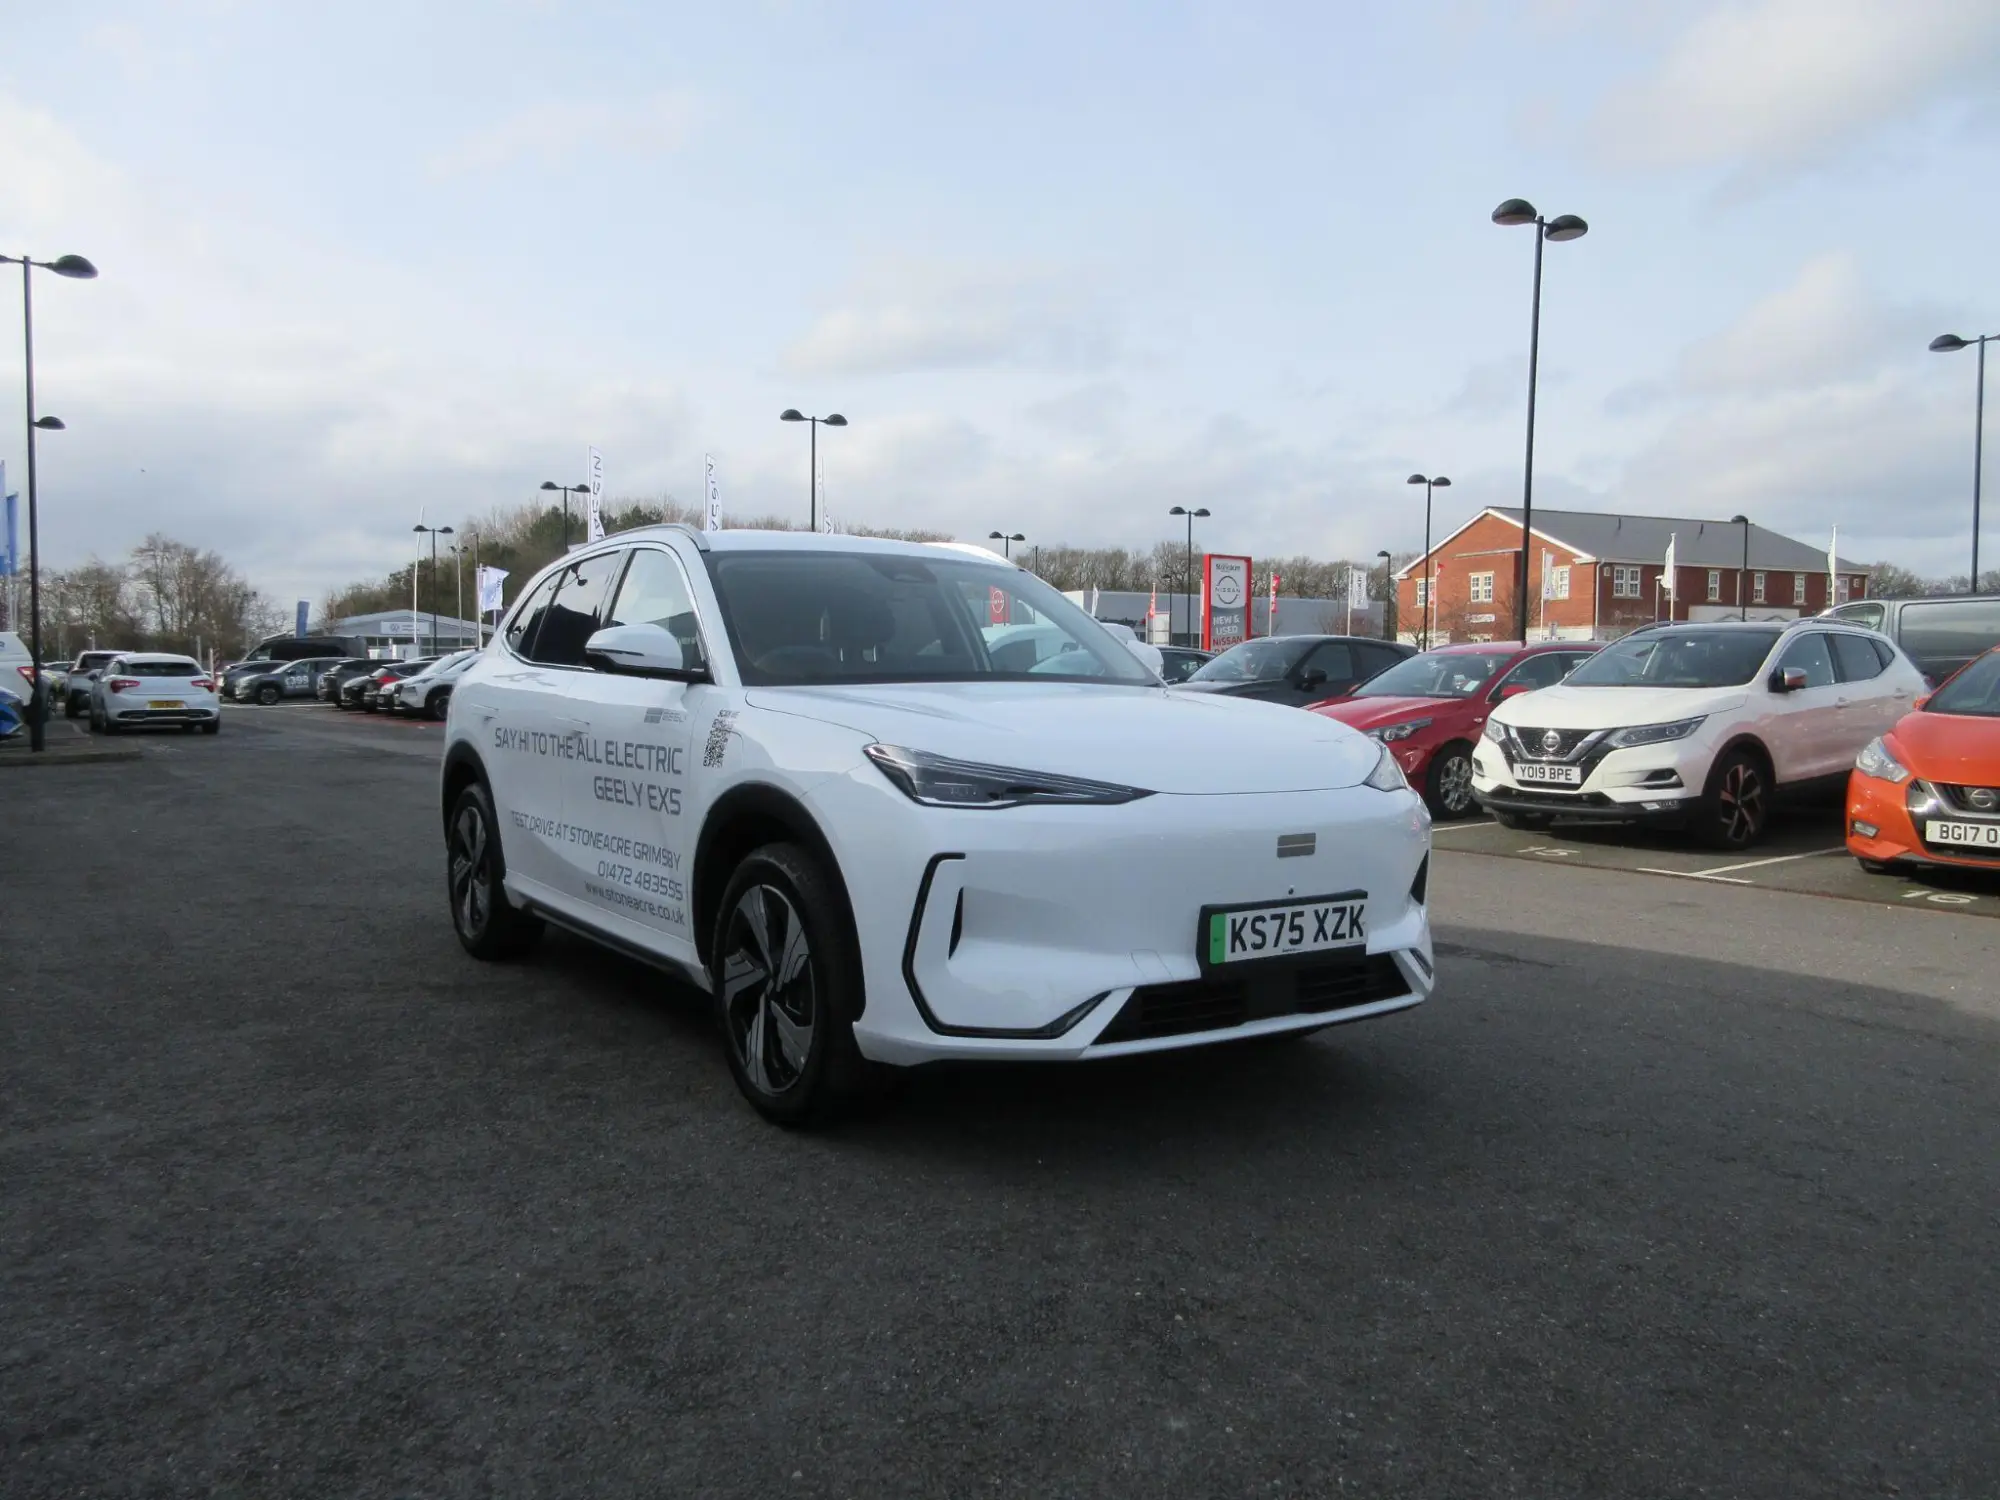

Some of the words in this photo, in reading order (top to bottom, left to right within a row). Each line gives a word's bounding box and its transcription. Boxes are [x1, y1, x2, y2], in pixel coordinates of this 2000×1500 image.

[708, 463, 719, 531] NISSA
[1213, 616, 1232, 626] NEW
[1216, 625, 1238, 635] USED
[1212, 636, 1243, 646] NISSAN
[495, 727, 517, 749] SAY
[519, 730, 529, 753] HI
[531, 731, 547, 756] TO
[549, 733, 574, 760] THE
[576, 735, 603, 764] ALL
[605, 740, 683, 775] ELECTRIC
[1520, 766, 1546, 779] YO19
[1549, 768, 1573, 781] BPE
[594, 775, 644, 808] GEELY
[647, 783, 682, 816] EX5
[511, 810, 529, 829] TEST
[529, 815, 554, 837] DRIVE
[554, 823, 569, 840] AT
[569, 826, 631, 857] STONEACRE
[633, 841, 681, 872] GRIMSBY
[1939, 823, 1980, 842] BG17
[1516, 846, 1581, 857] 15
[597, 860, 632, 886] 01472
[634, 870, 684, 902] 483555
[1900, 890, 1979, 903] 16
[1230, 910, 1305, 953] KS75
[1313, 904, 1365, 943] XZK
